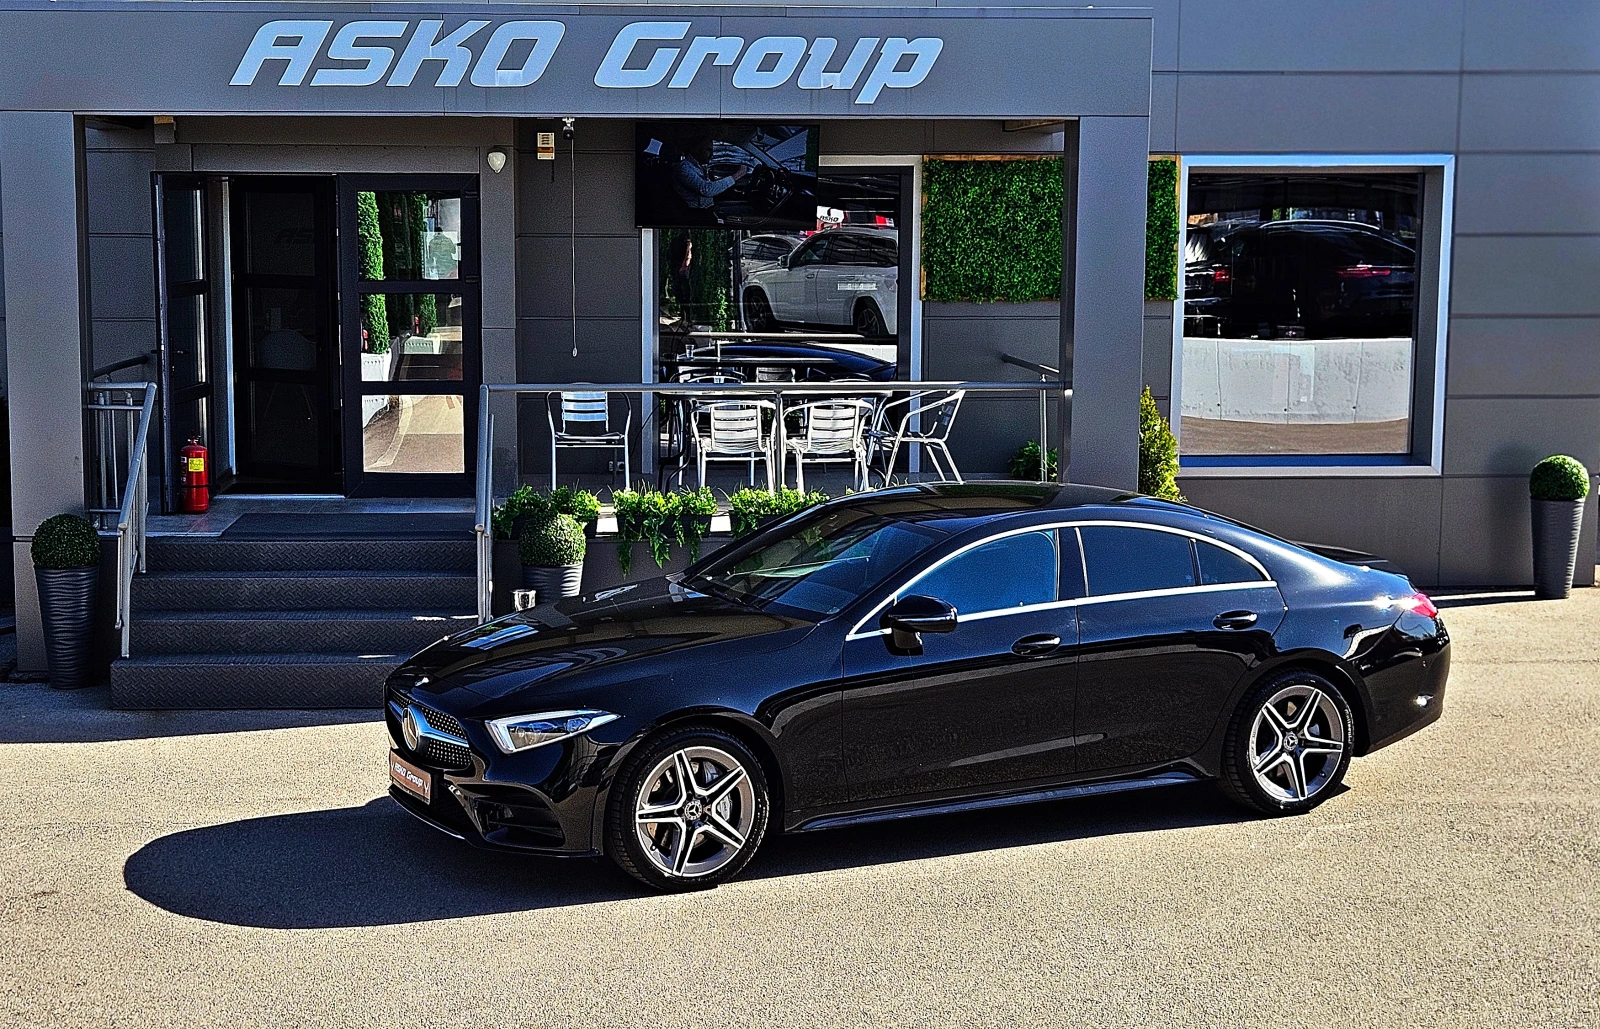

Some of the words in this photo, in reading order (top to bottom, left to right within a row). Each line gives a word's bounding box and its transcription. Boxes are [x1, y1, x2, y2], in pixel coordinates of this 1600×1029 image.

[229, 20, 566, 87] ASKO
[594, 21, 944, 104] Group
[406, 770, 424, 788] Group
